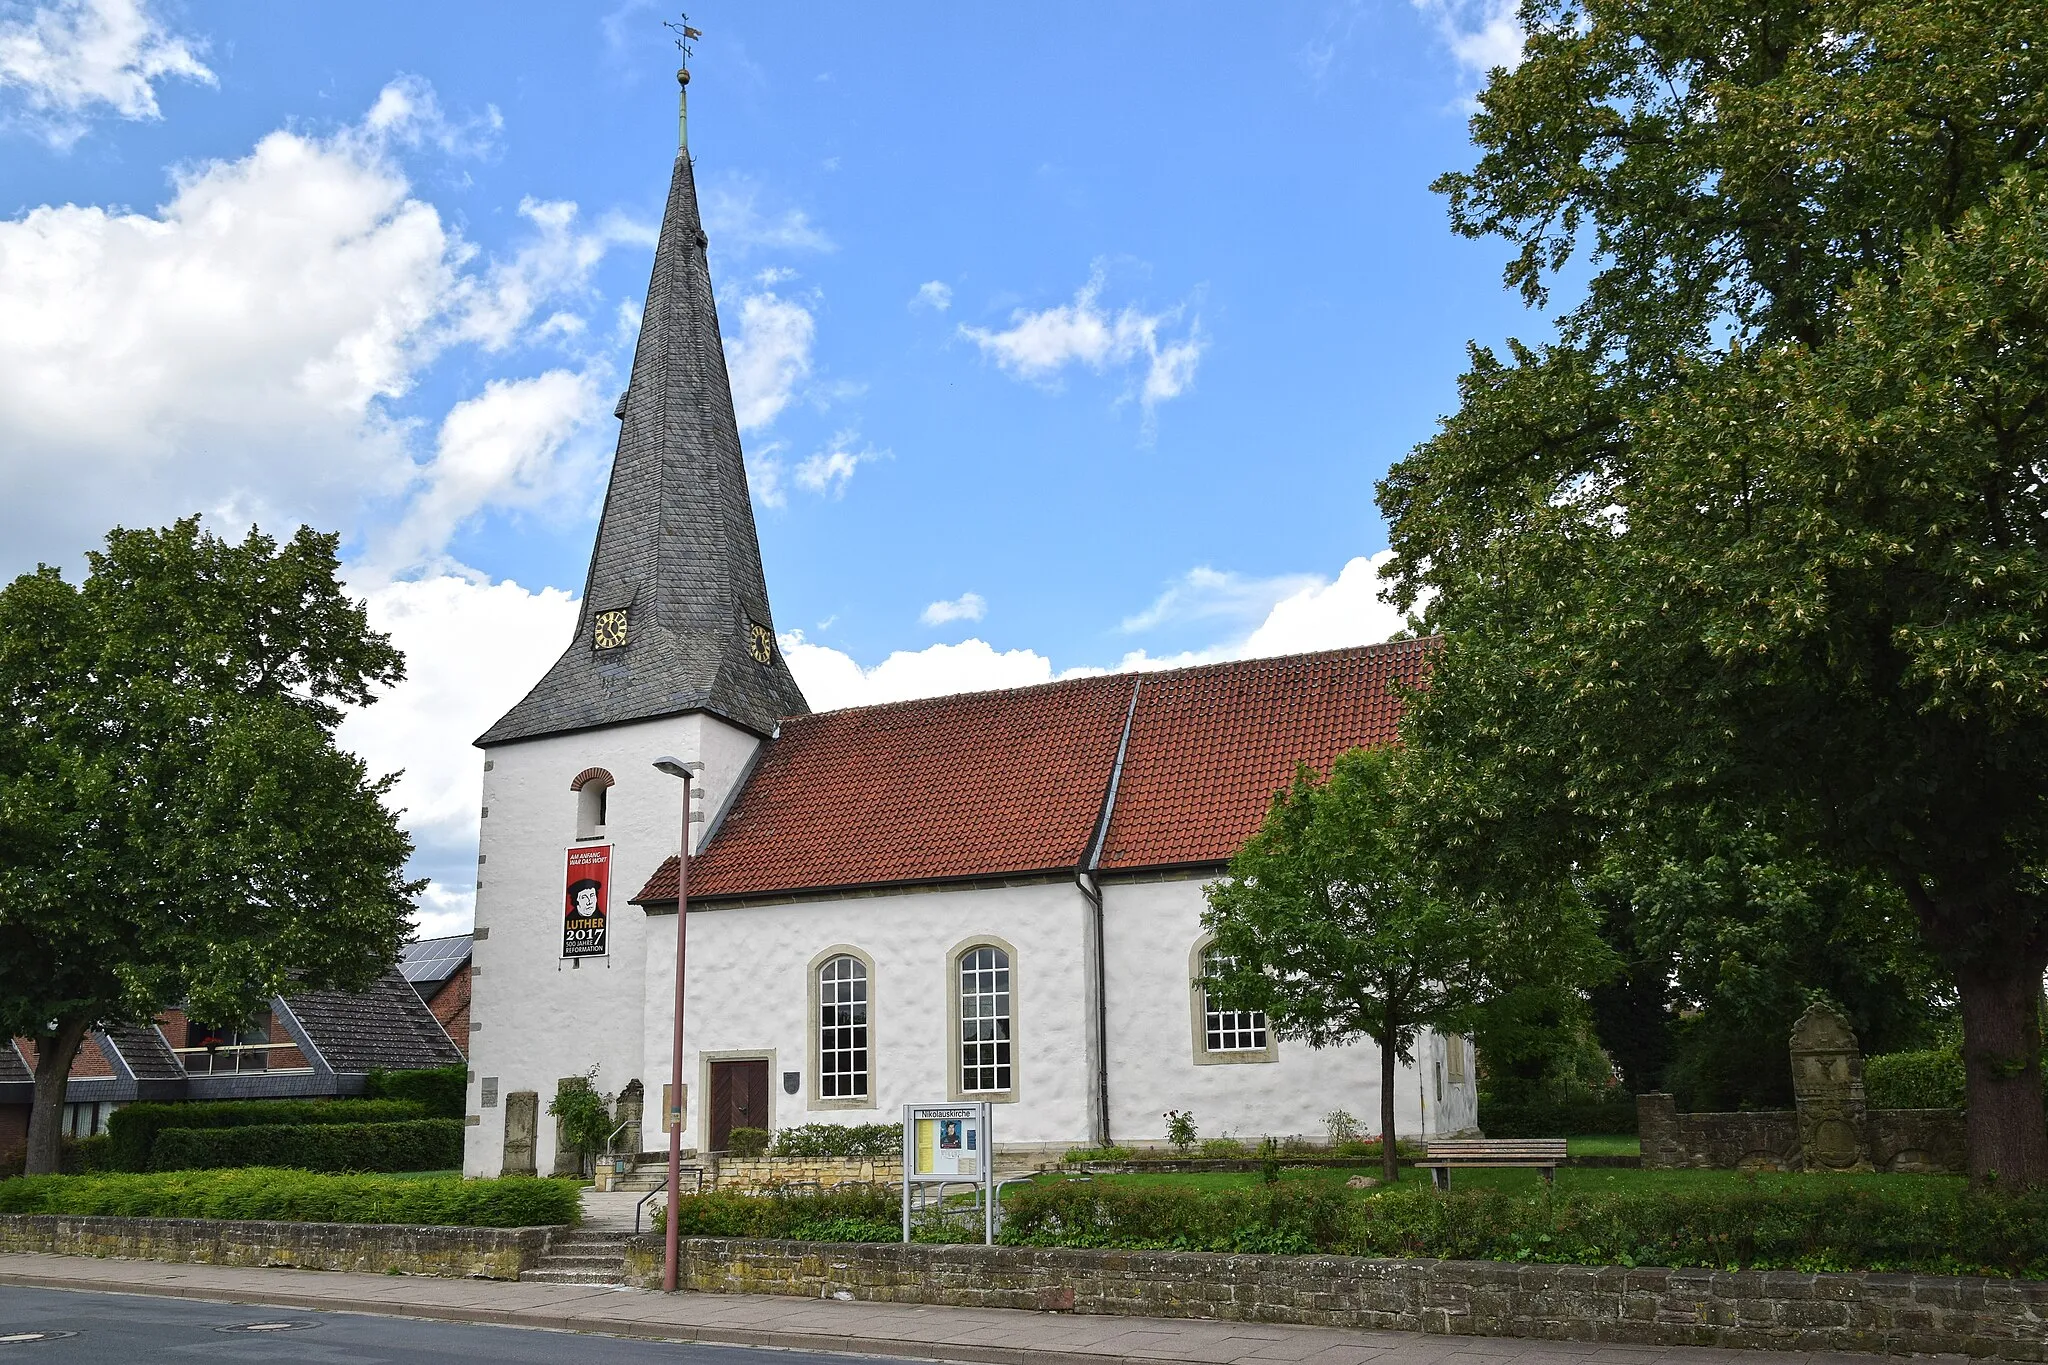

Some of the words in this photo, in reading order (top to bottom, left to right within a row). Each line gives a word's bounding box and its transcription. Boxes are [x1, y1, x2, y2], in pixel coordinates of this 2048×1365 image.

[566, 918, 604, 930] LUTHER
[566, 929, 604, 945] 2017
[565, 945, 603, 953] REFORMATION
[921, 1110, 971, 1118] Nikolauskirche
